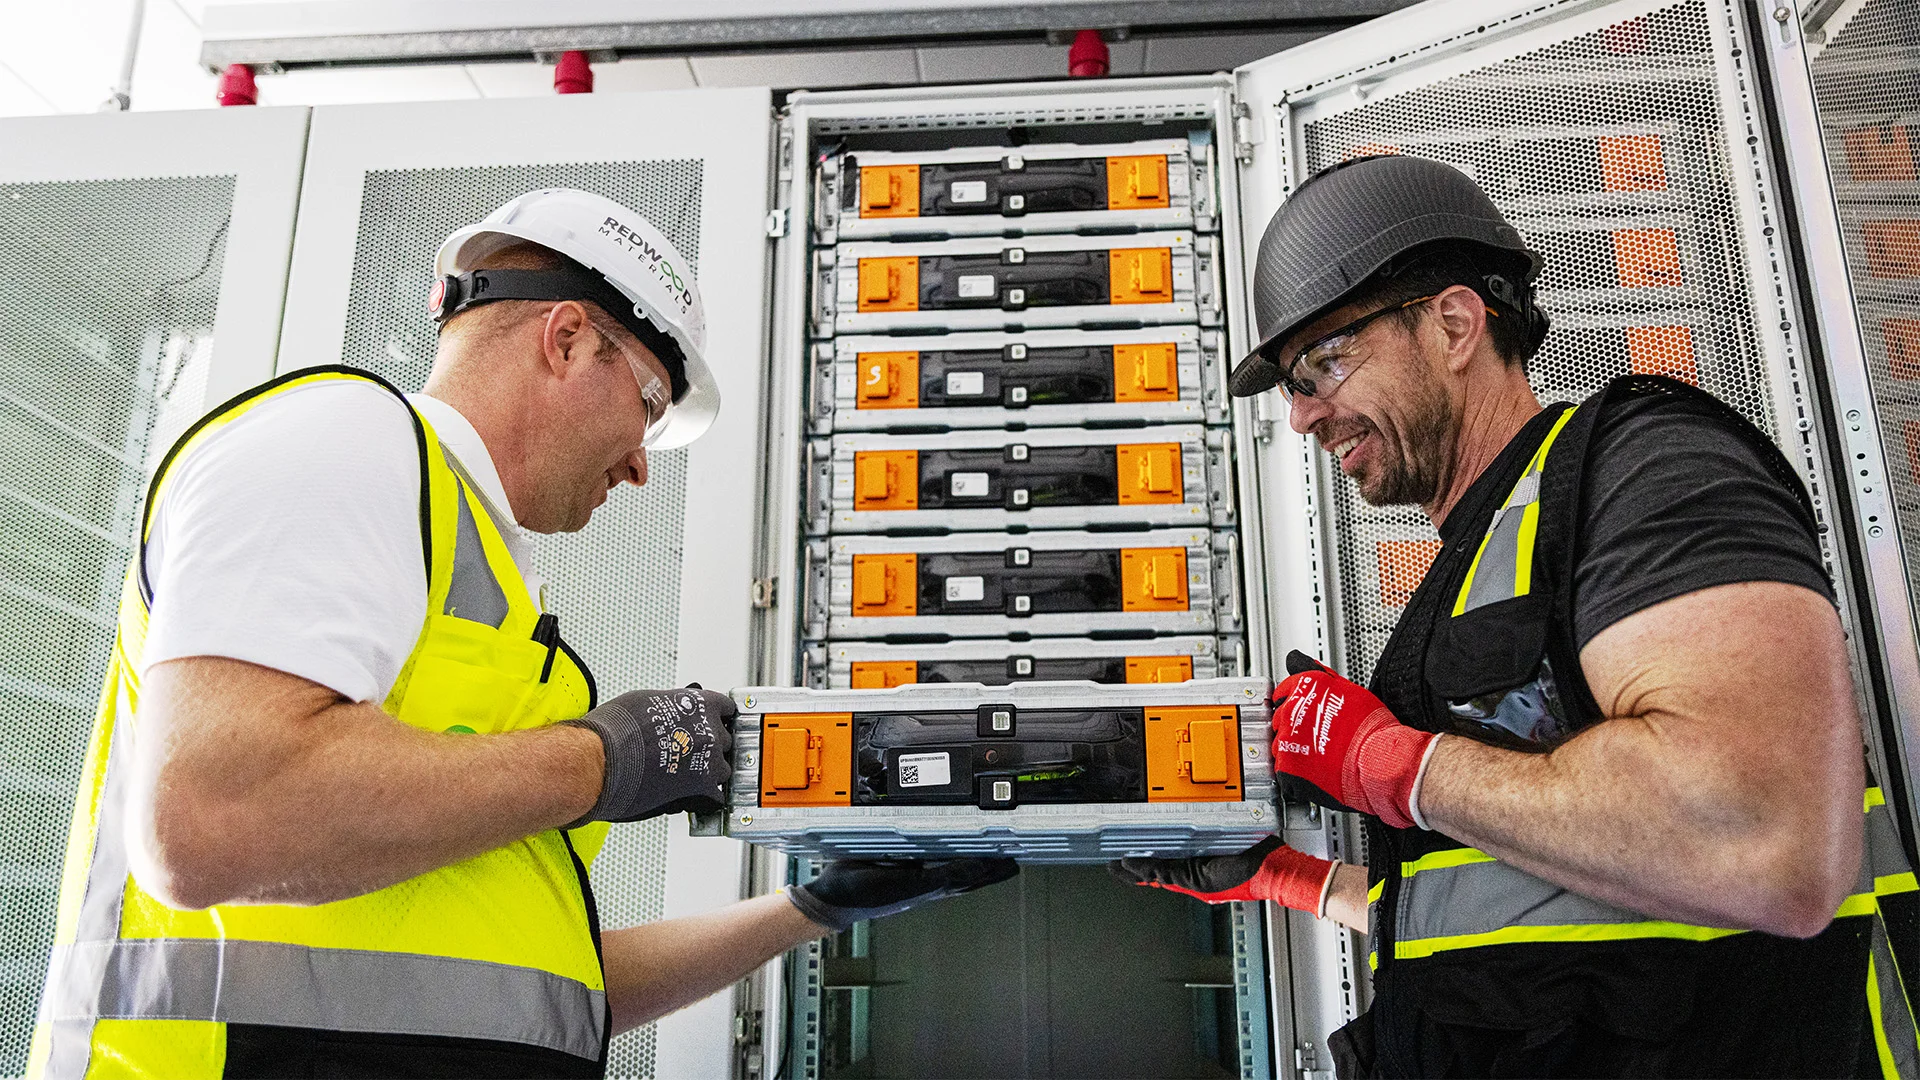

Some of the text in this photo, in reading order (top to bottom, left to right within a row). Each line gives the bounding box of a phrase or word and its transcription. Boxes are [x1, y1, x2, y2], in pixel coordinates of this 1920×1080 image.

[598, 226, 687, 314] MATERIALS
[603, 216, 692, 306] REDWOOD
[1318, 693, 1345, 755] Milwaukee
